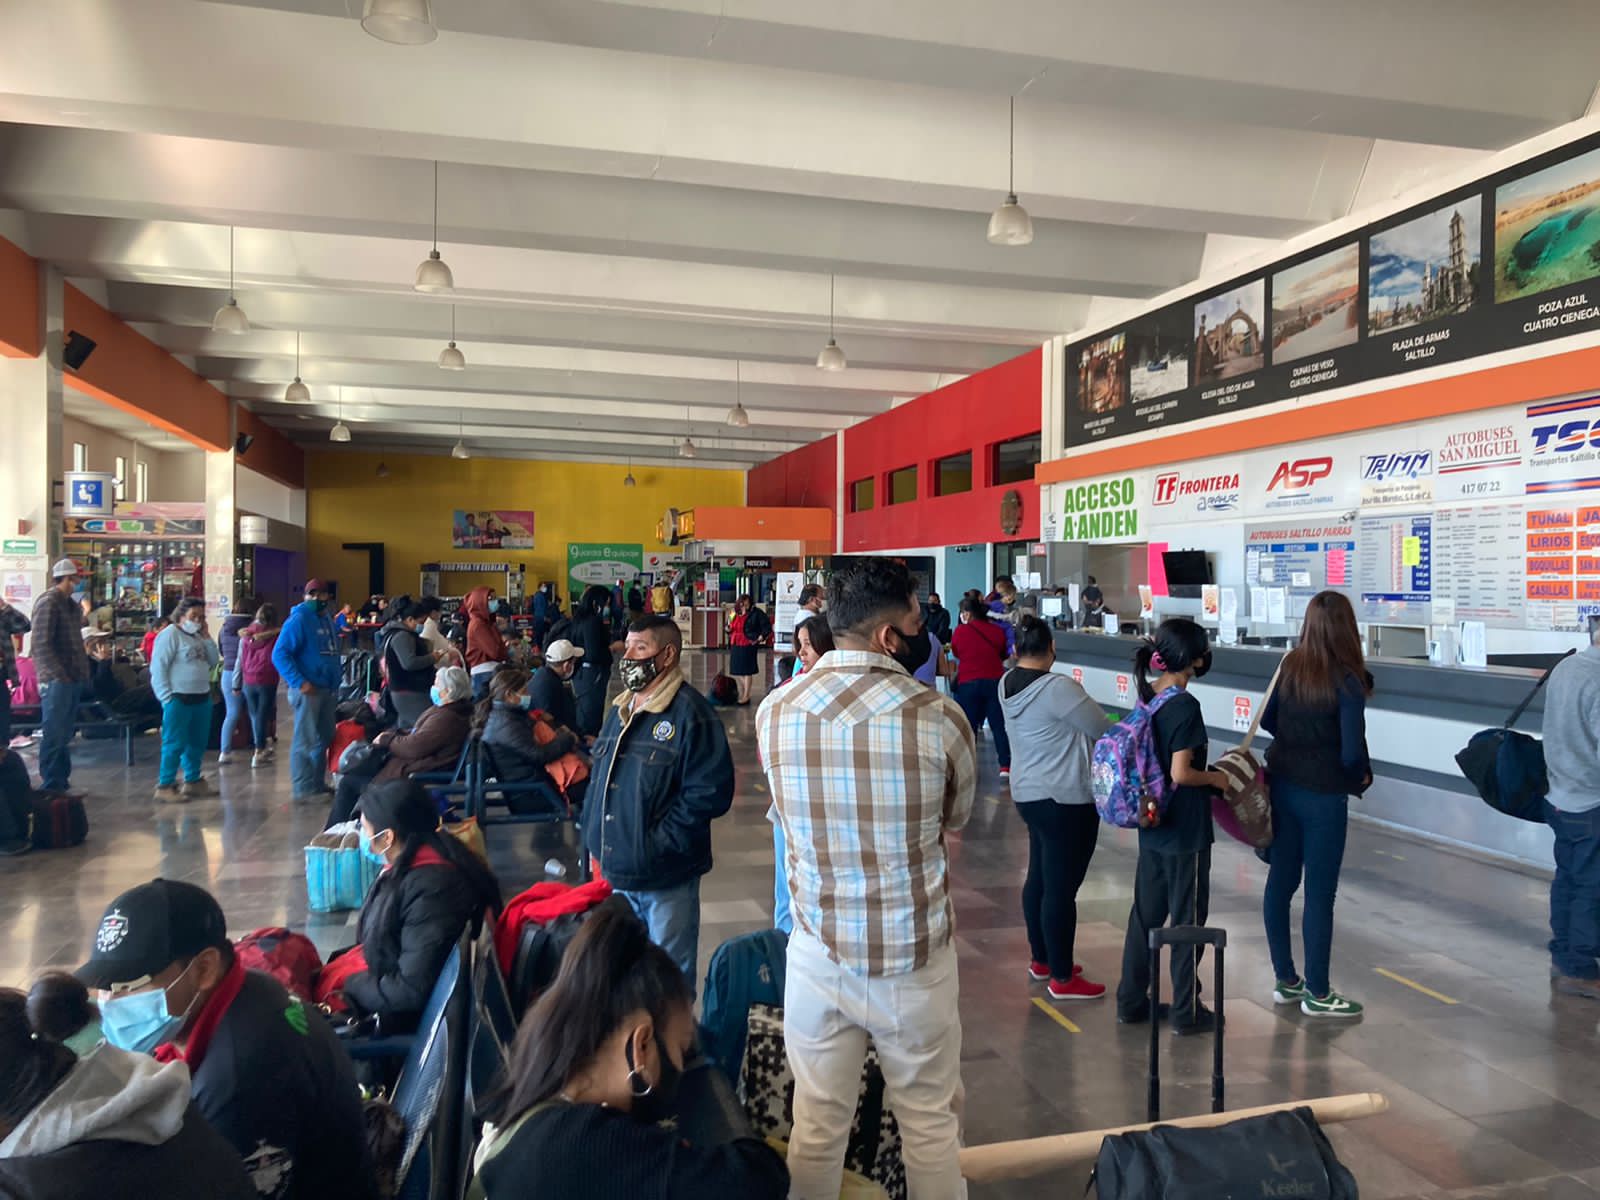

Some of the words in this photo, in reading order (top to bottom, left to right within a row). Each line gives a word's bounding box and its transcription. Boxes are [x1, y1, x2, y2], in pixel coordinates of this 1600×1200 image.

[1538, 299, 1563, 315] POZA
[1564, 294, 1588, 309] AZUL
[1523, 315, 1559, 333] CUATRO
[1392, 338, 1414, 352] PLAZA
[1414, 335, 1425, 346] DE
[1425, 328, 1450, 344] ARMAS
[1404, 345, 1436, 361] SALTILLO
[1311, 362, 1320, 372] DE
[1289, 375, 1311, 388] CUATRO
[1445, 425, 1513, 448] AUTOBUSES
[1439, 446, 1464, 463] SAN
[1466, 438, 1521, 460] MIGUEL
[1530, 455, 1569, 467] Transportes
[1266, 456, 1333, 492] ASP
[1157, 477, 1177, 501] TF
[1179, 473, 1240, 496] FRONTERA
[1460, 482, 1476, 495] 417
[1477, 481, 1489, 493] 07
[1489, 480, 1501, 492] 22
[1064, 477, 1135, 514] ACCESO
[1530, 511, 1570, 526] TUNAL
[1289, 527, 1321, 538] SALTILLO
[1530, 535, 1570, 548] LIRIOS
[1529, 584, 1570, 597] CASILLAS
[1577, 604, 1600, 615] INFO
